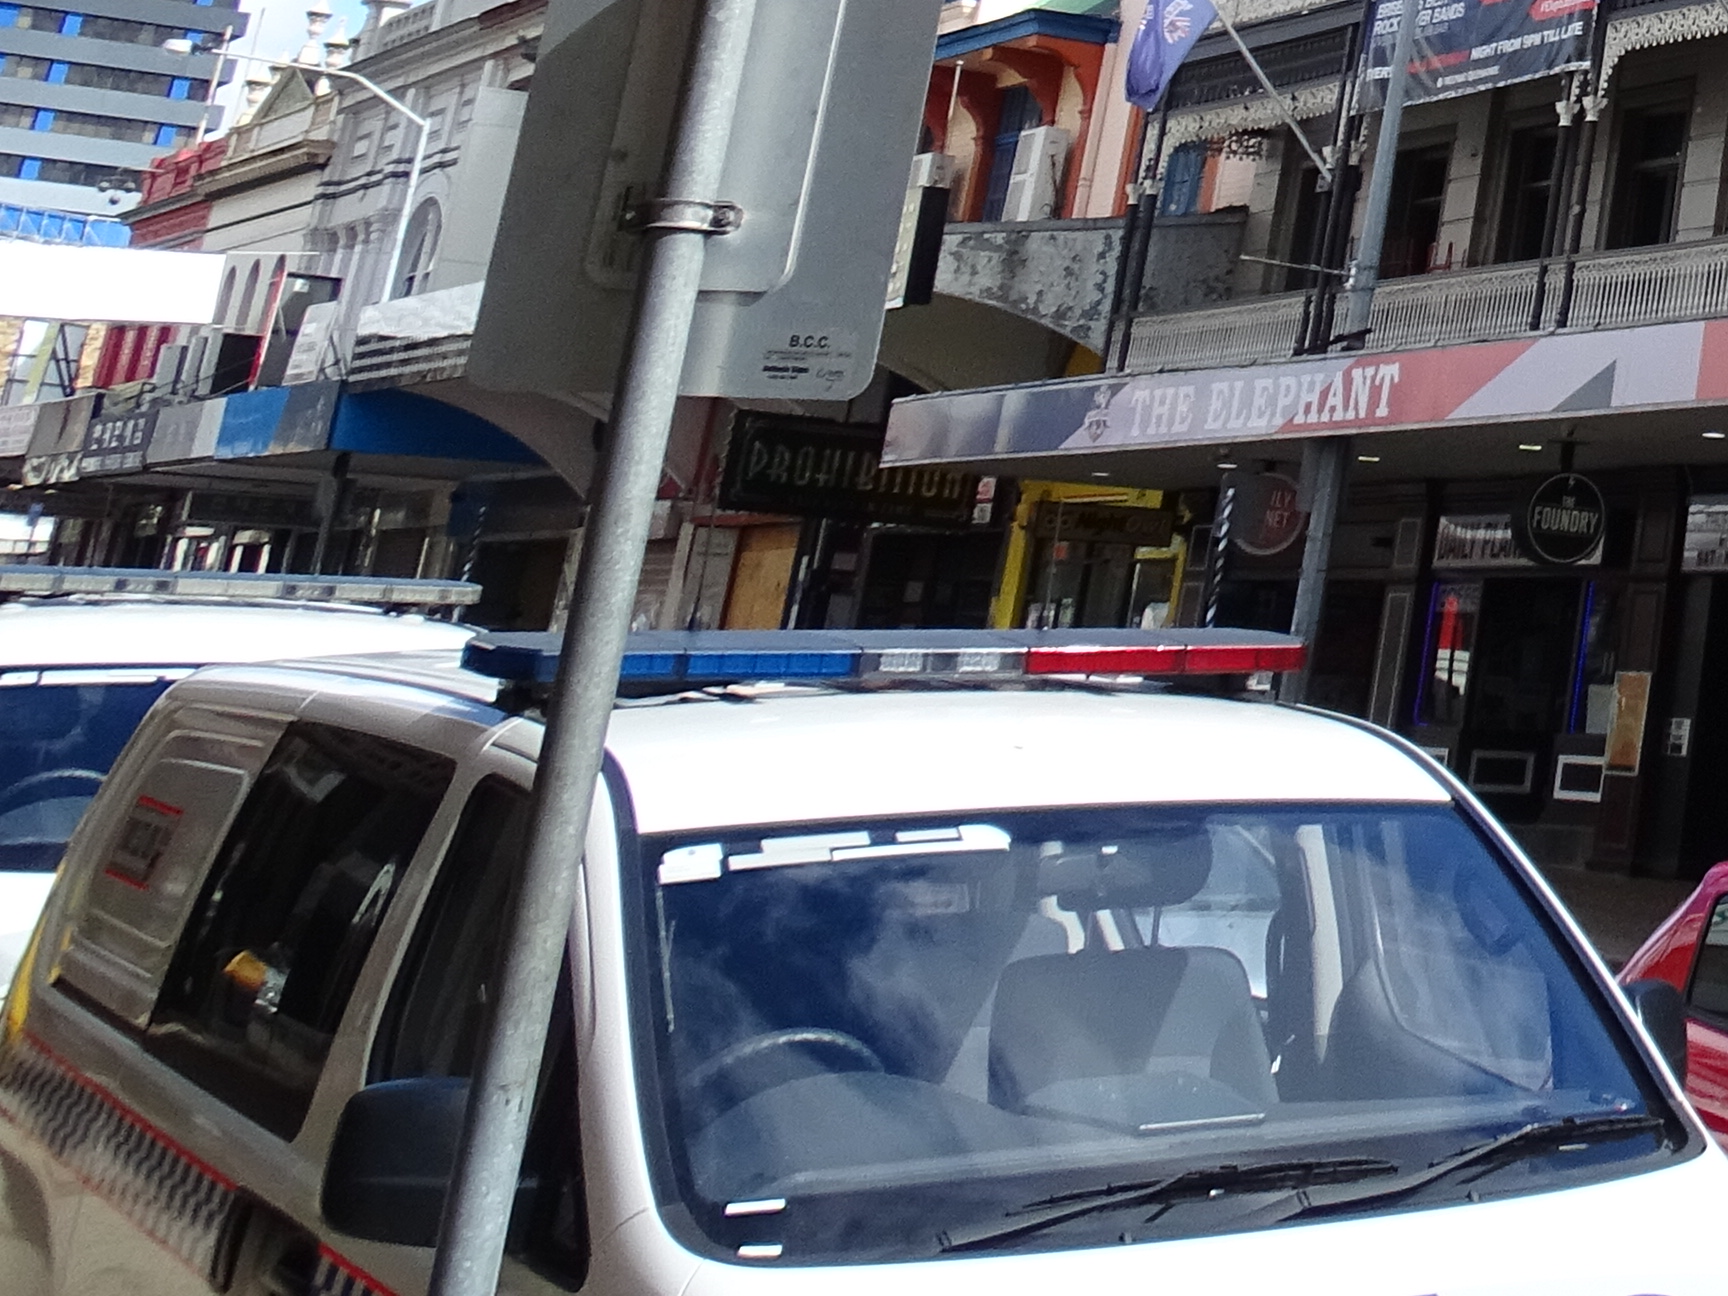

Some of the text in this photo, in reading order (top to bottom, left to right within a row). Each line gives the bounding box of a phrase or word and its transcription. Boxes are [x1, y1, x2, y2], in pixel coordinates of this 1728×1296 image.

[1432, 2, 1465, 23] BANDS
[1470, 42, 1498, 61] NIGHT
[1497, 36, 1522, 54] FROM
[1542, 28, 1561, 44] TILL
[1560, 21, 1584, 39] LATE
[789, 334, 831, 349] B.C.C.
[1130, 361, 1400, 437] THE ELEPHANT
[1532, 505, 1599, 535] FOUNDRY
